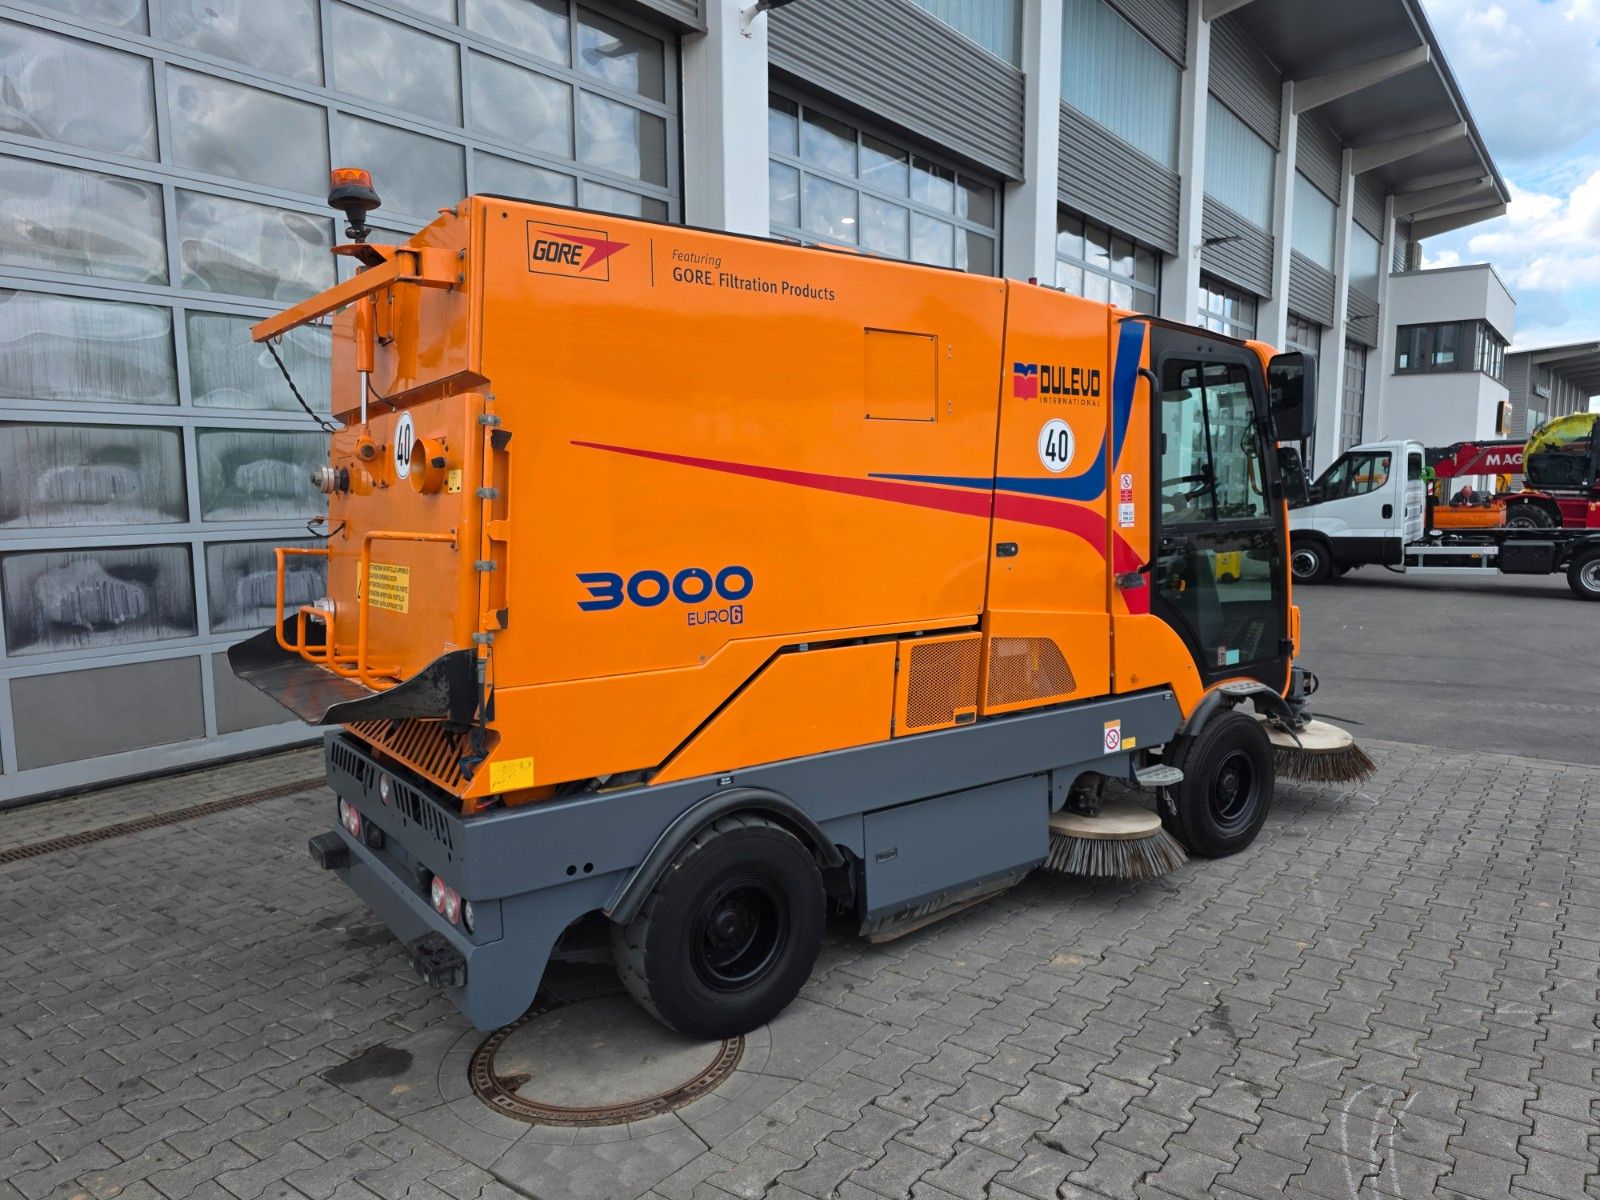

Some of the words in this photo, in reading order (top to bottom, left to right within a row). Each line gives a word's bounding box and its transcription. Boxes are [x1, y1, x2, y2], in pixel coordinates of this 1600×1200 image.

[533, 240, 583, 265] GORE
[671, 249, 722, 269] Featuring
[719, 272, 778, 294] Filtration
[781, 281, 836, 301] Products
[1040, 364, 1100, 397] DULEVO
[1040, 396, 1101, 407] INTERNATIONAL
[397, 423, 410, 466] 40
[1045, 429, 1069, 462] 40
[575, 565, 754, 612] 3000
